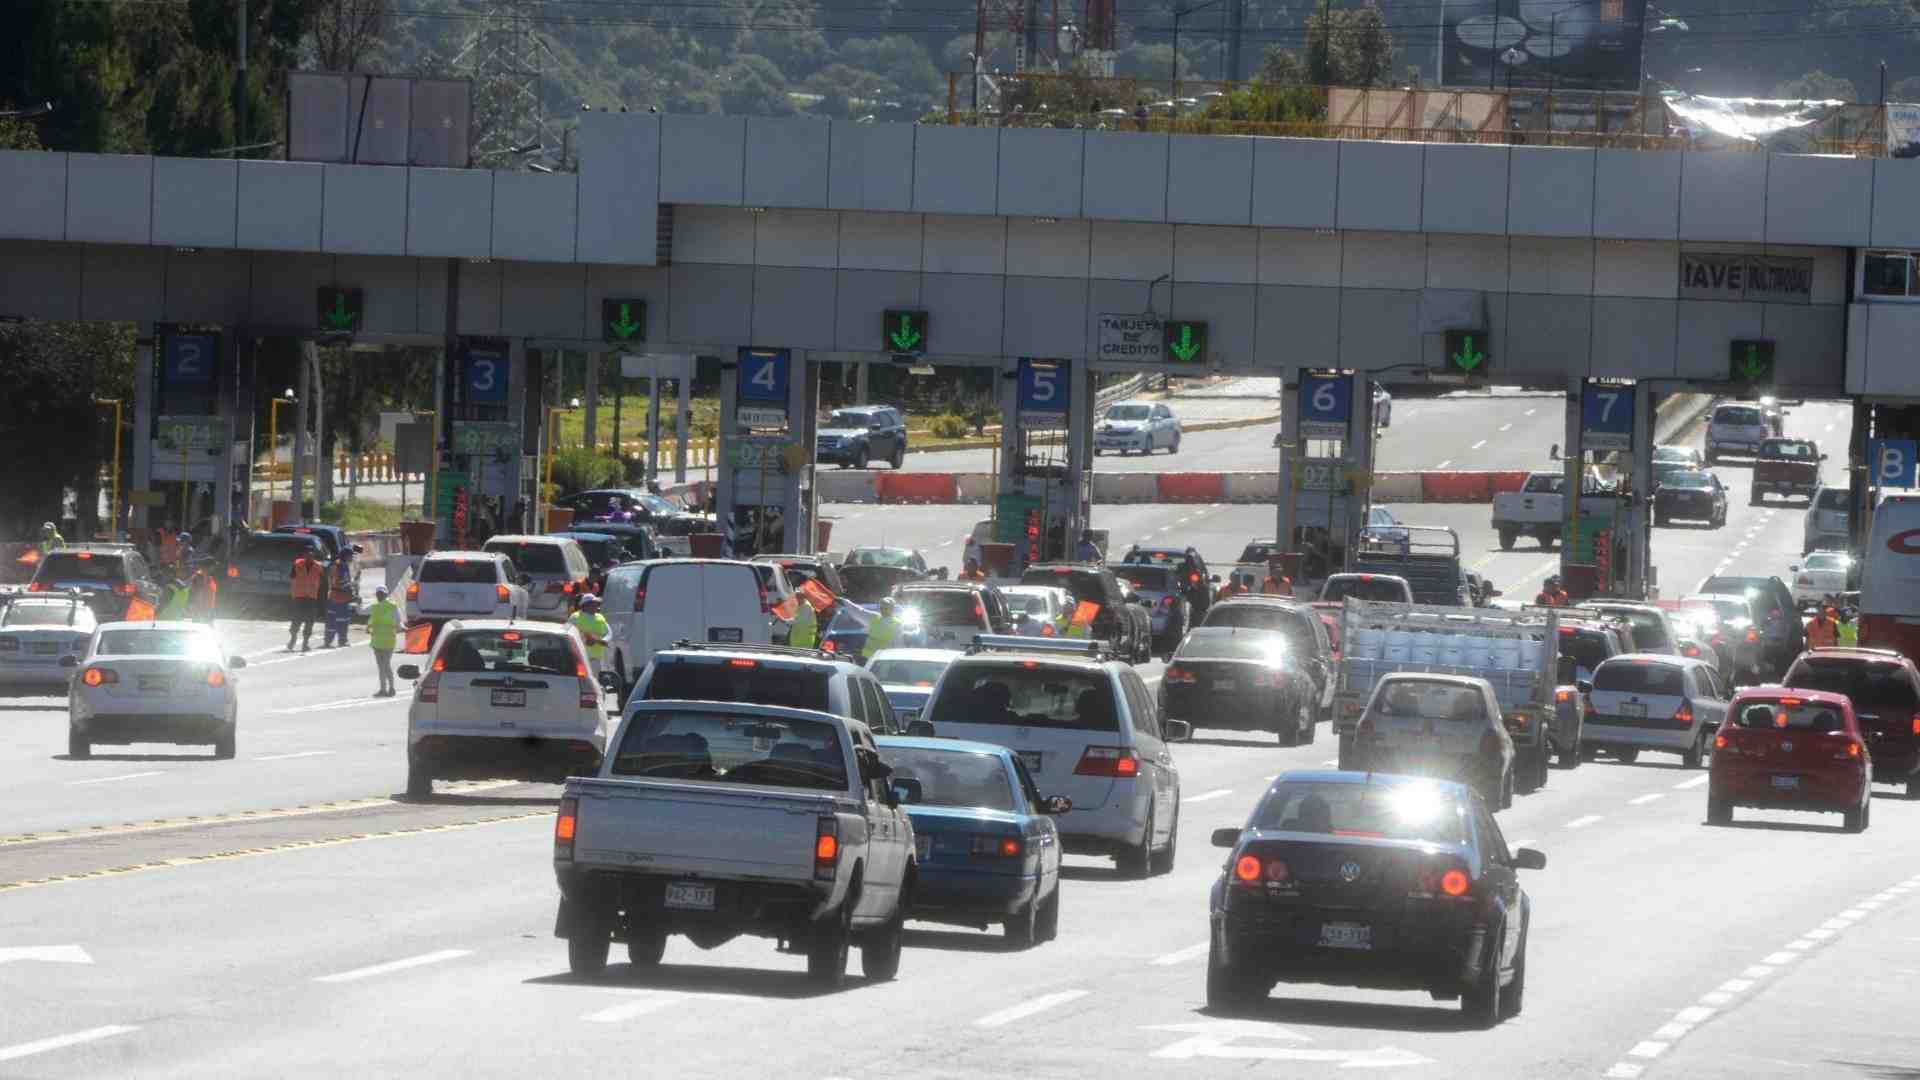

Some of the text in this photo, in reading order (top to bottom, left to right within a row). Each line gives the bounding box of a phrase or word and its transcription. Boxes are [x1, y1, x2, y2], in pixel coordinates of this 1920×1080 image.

[1684, 263, 1743, 290] IAVE
[1102, 318, 1161, 331] TARJETA
[177, 343, 201, 376] 2
[1102, 343, 1160, 355] CREDITO
[472, 359, 496, 391] 3
[751, 360, 776, 392] 4
[1031, 371, 1057, 401] 5
[1312, 382, 1337, 412] 6
[1596, 392, 1619, 423] 7
[1882, 446, 1904, 478] 8
